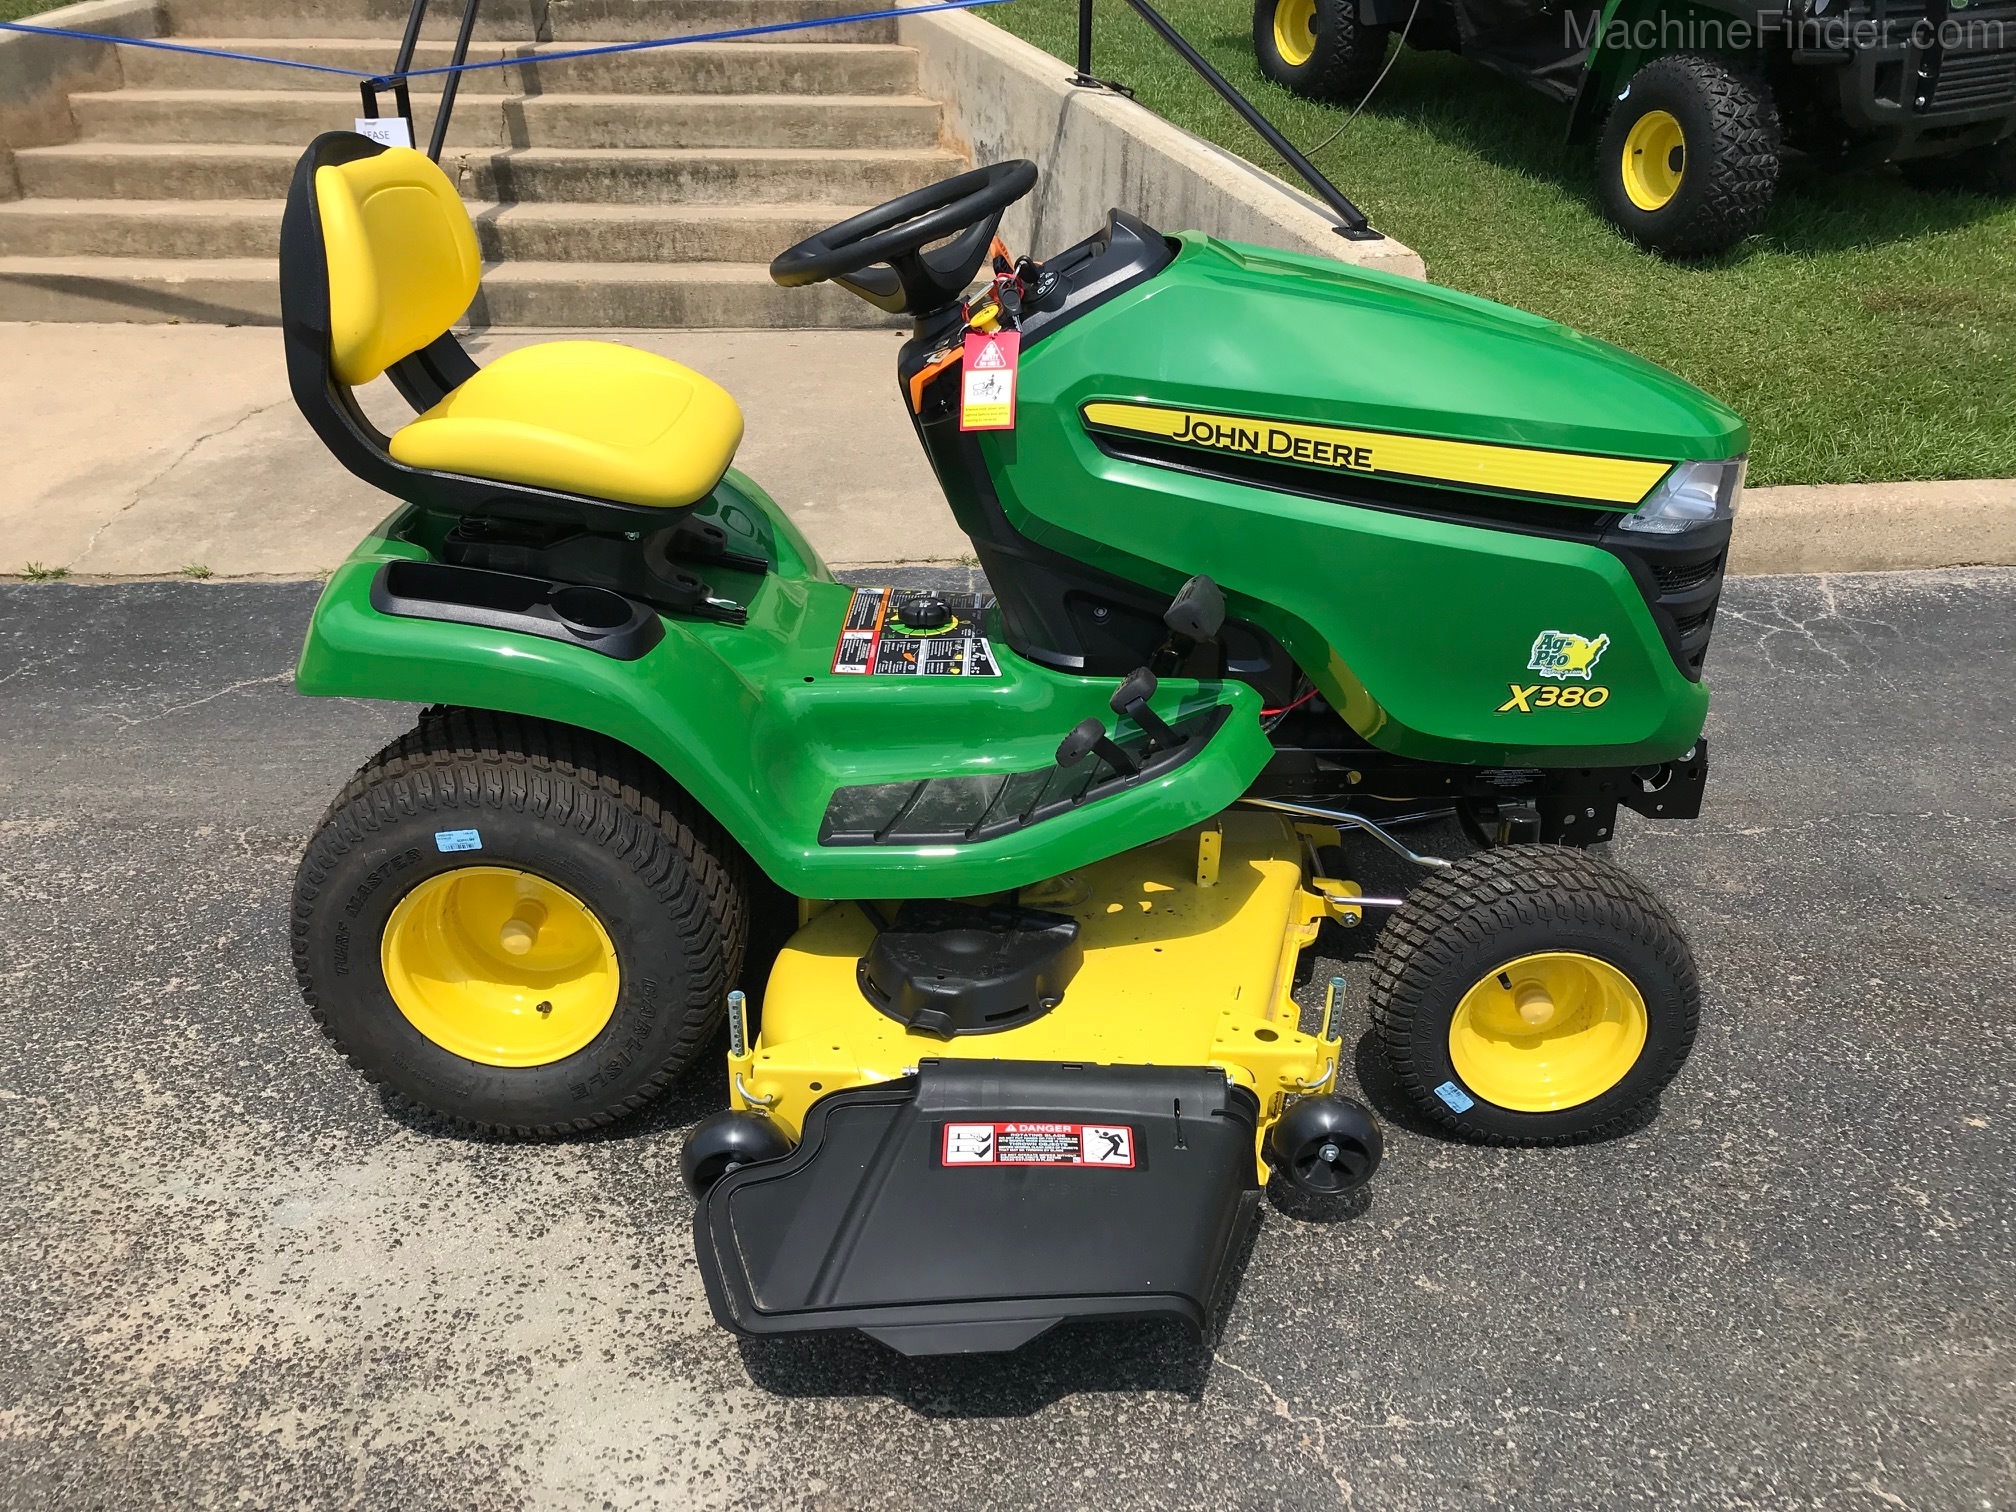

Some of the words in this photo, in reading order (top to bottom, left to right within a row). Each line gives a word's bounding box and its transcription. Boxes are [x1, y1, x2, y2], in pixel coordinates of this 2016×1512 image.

[1173, 415, 1259, 451] JOHN
[1267, 428, 1373, 469] DEERE
[1532, 650, 1569, 667] Pro
[1495, 684, 1610, 712] X380
[334, 919, 351, 977] TURF
[343, 847, 423, 919] MASTER
[568, 977, 658, 1101] CARLISLE
[1019, 1124, 1072, 1133] DANGER
